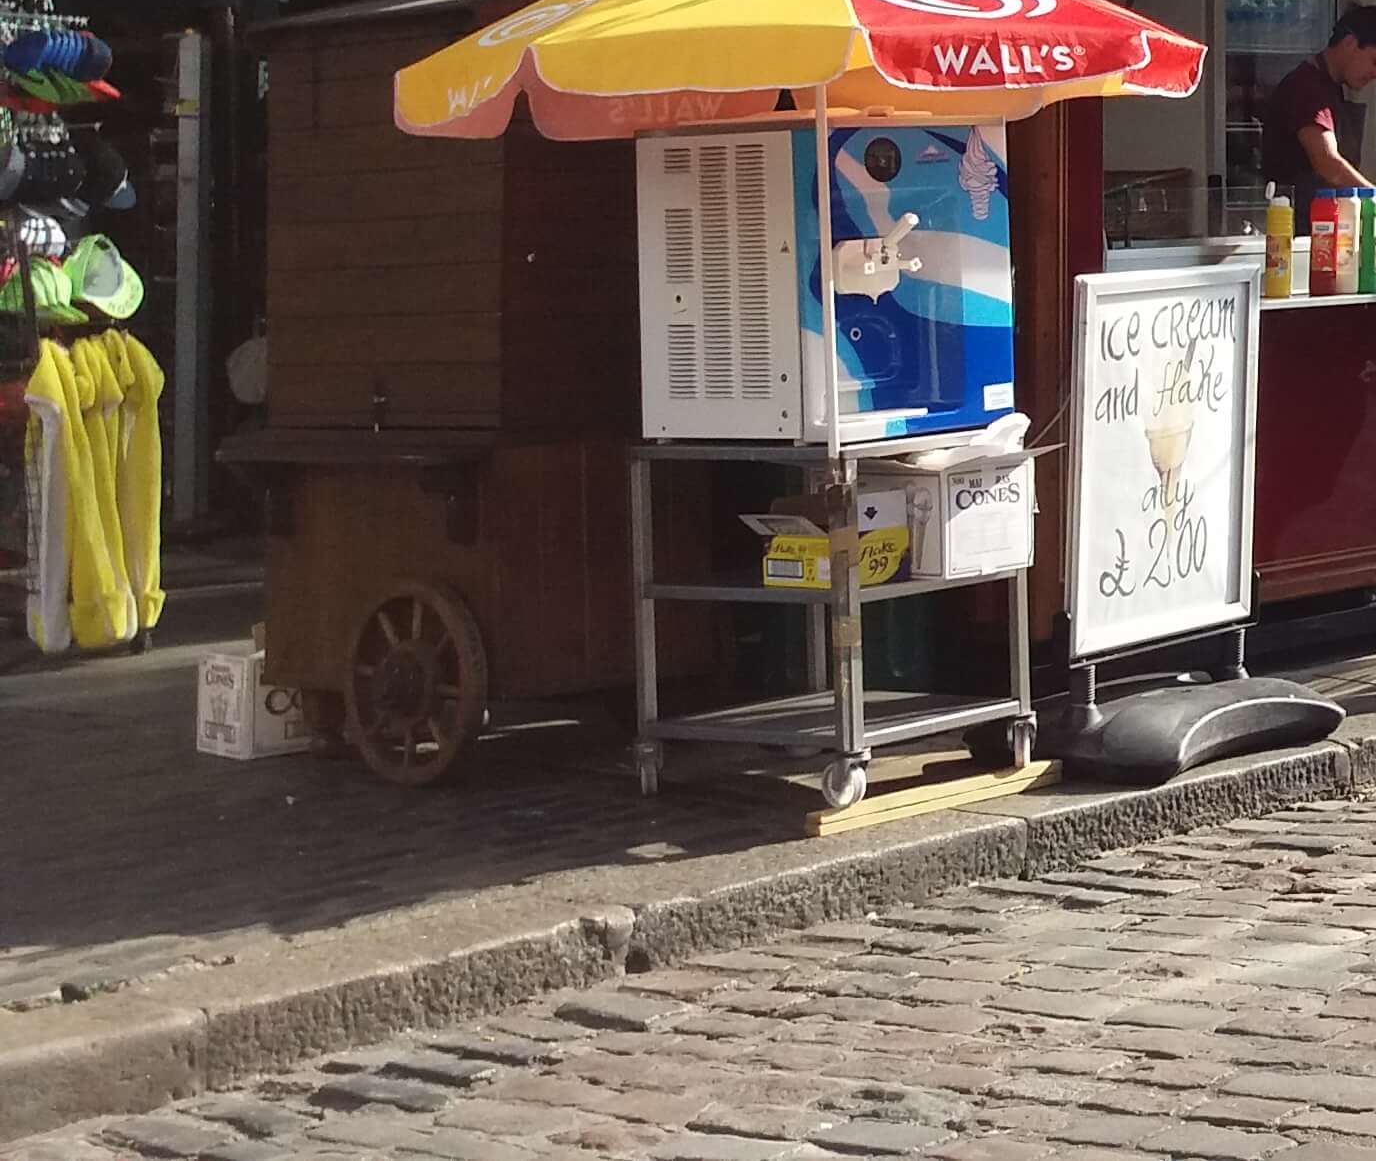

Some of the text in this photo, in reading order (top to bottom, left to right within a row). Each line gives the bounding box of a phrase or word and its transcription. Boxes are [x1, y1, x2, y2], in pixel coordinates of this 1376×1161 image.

[933, 44, 1076, 75] WALL'S
[1095, 368, 1139, 423] and
[955, 482, 1021, 510] CONES
[868, 556, 889, 578] 99
